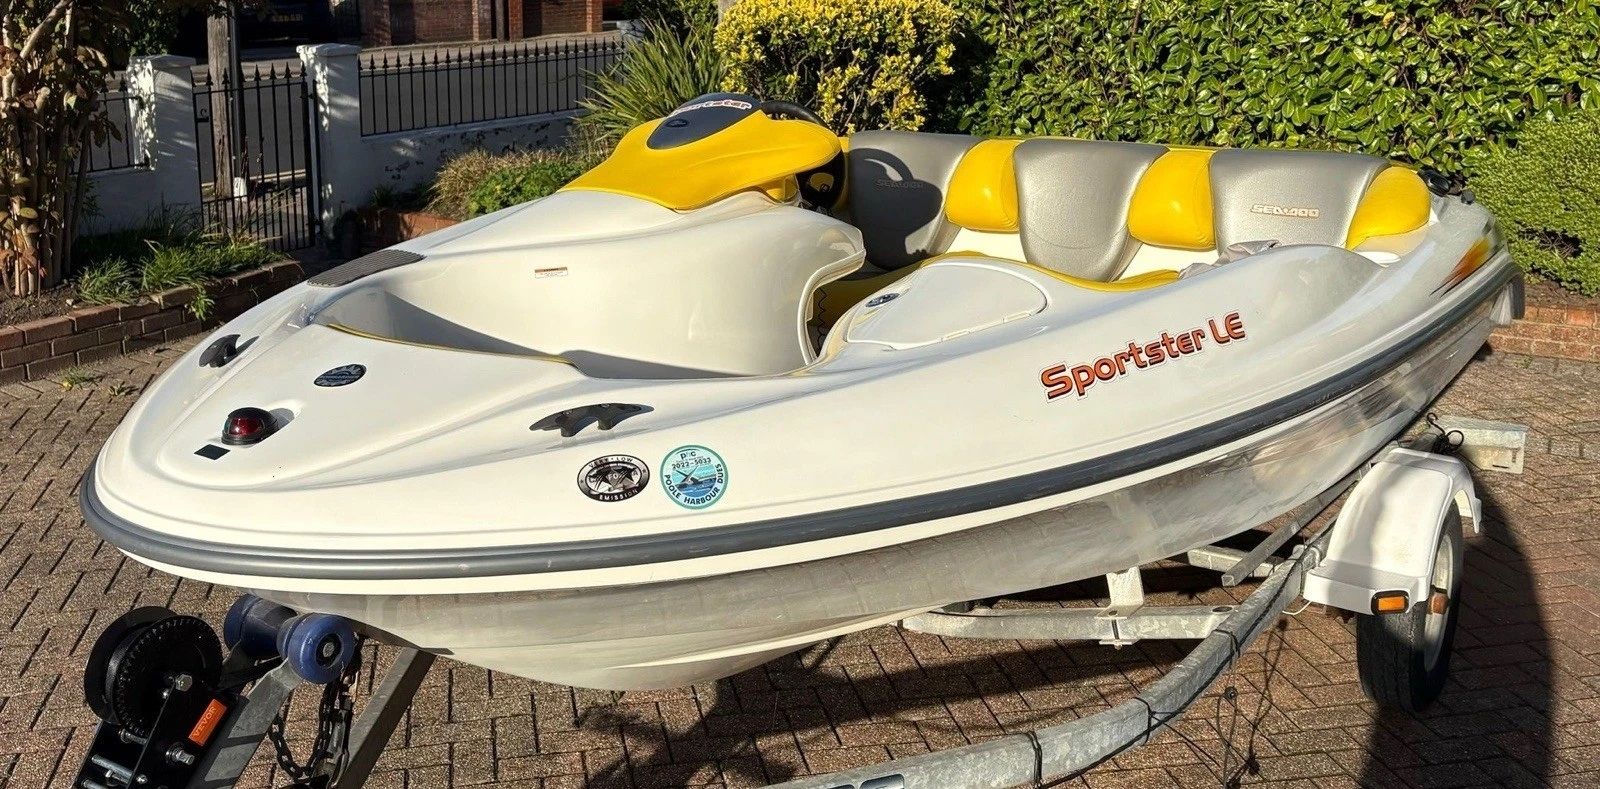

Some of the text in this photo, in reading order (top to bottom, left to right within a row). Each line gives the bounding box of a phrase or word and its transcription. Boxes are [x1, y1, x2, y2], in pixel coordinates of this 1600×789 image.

[1040, 311, 1246, 400] Sportster LE
[599, 489, 638, 501] EMISSION
[663, 474, 682, 499] POOLE
[683, 486, 721, 505] HARBOUR
[714, 463, 724, 484] DUES
